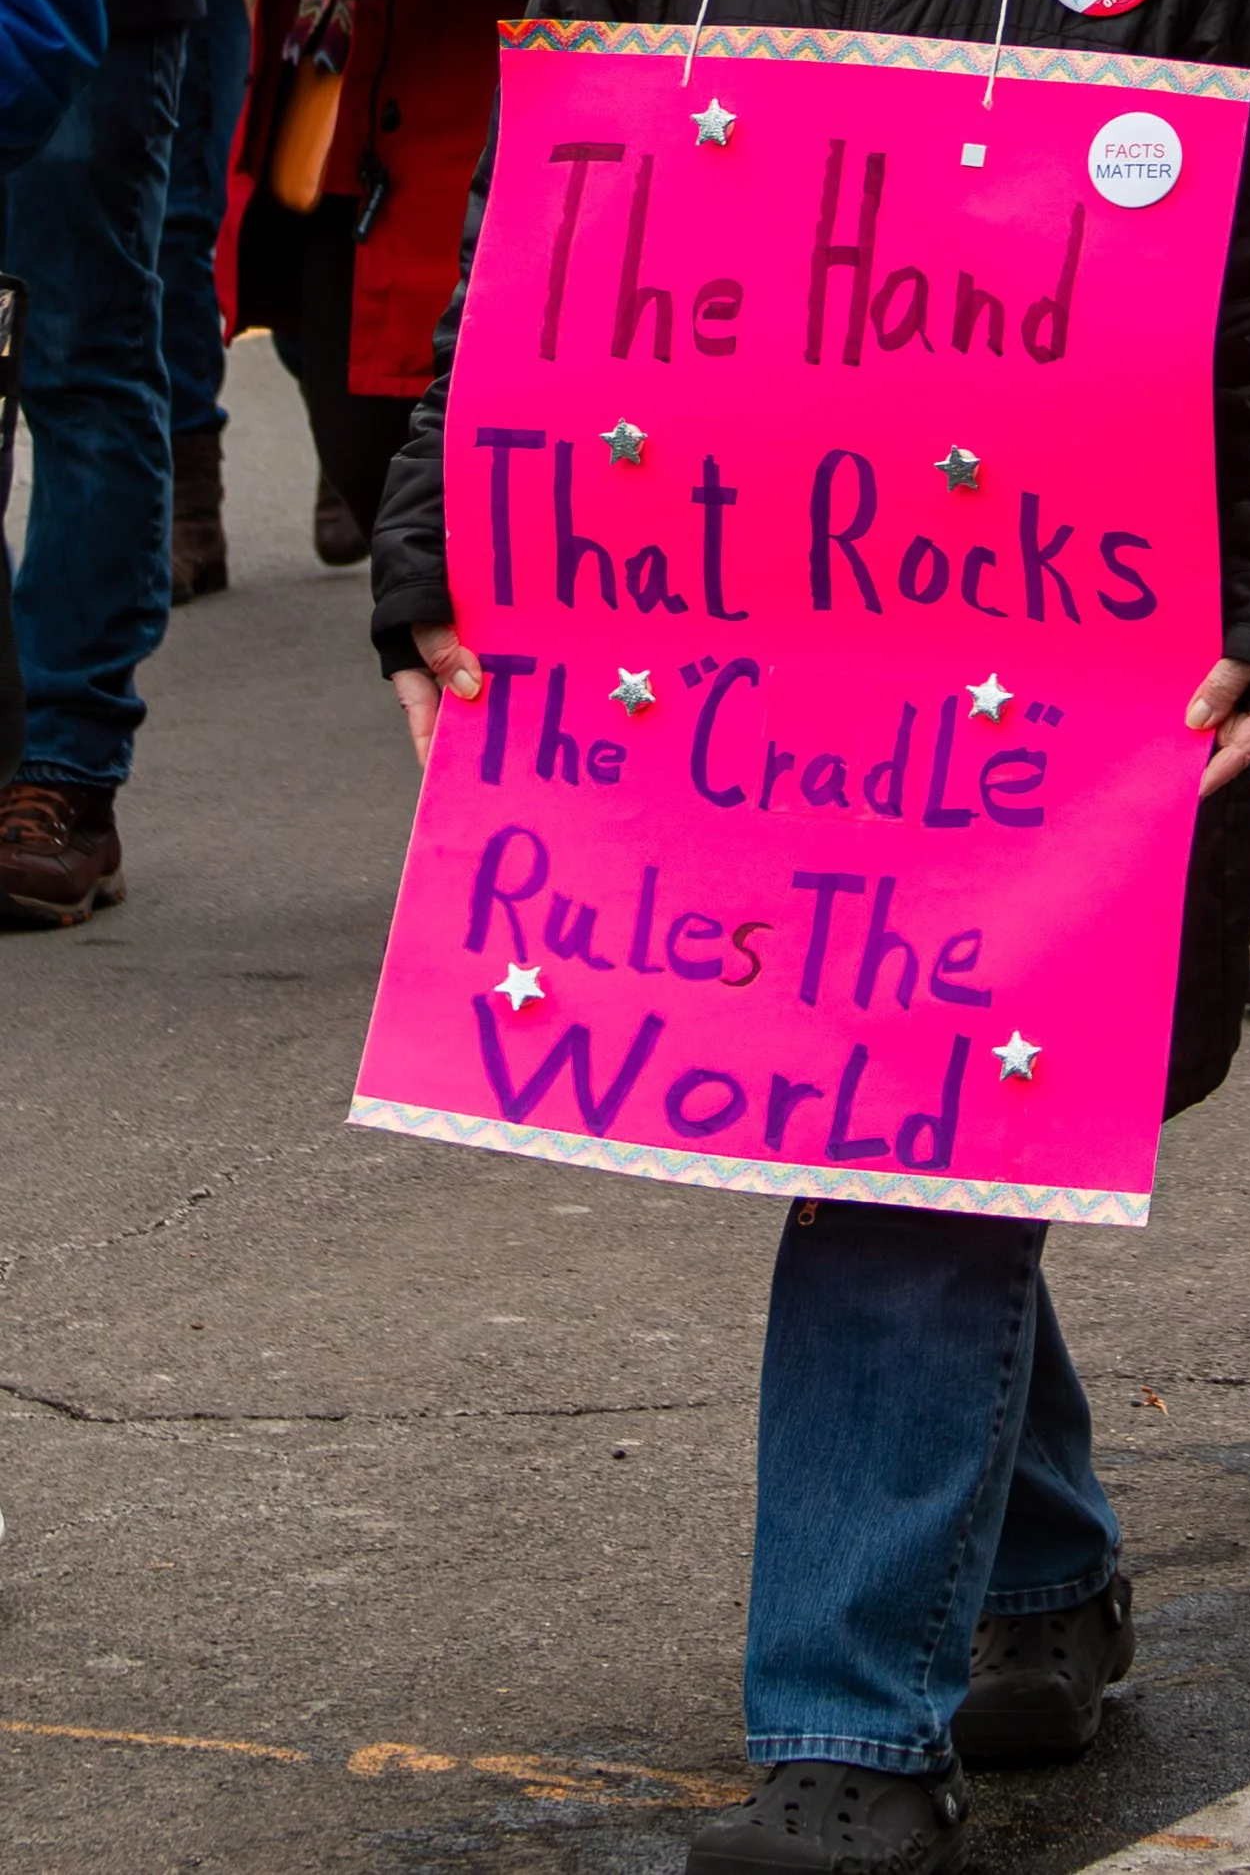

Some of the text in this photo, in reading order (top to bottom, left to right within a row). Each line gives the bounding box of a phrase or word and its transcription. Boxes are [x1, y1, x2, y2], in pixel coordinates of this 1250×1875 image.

[1096, 163, 1172, 180] MATTER
[1104, 143, 1166, 159] FACTS
[537, 138, 1086, 368] The Hand
[473, 427, 1158, 626] That Rocks
[478, 653, 628, 786] The
[463, 824, 993, 1011] Rules The
